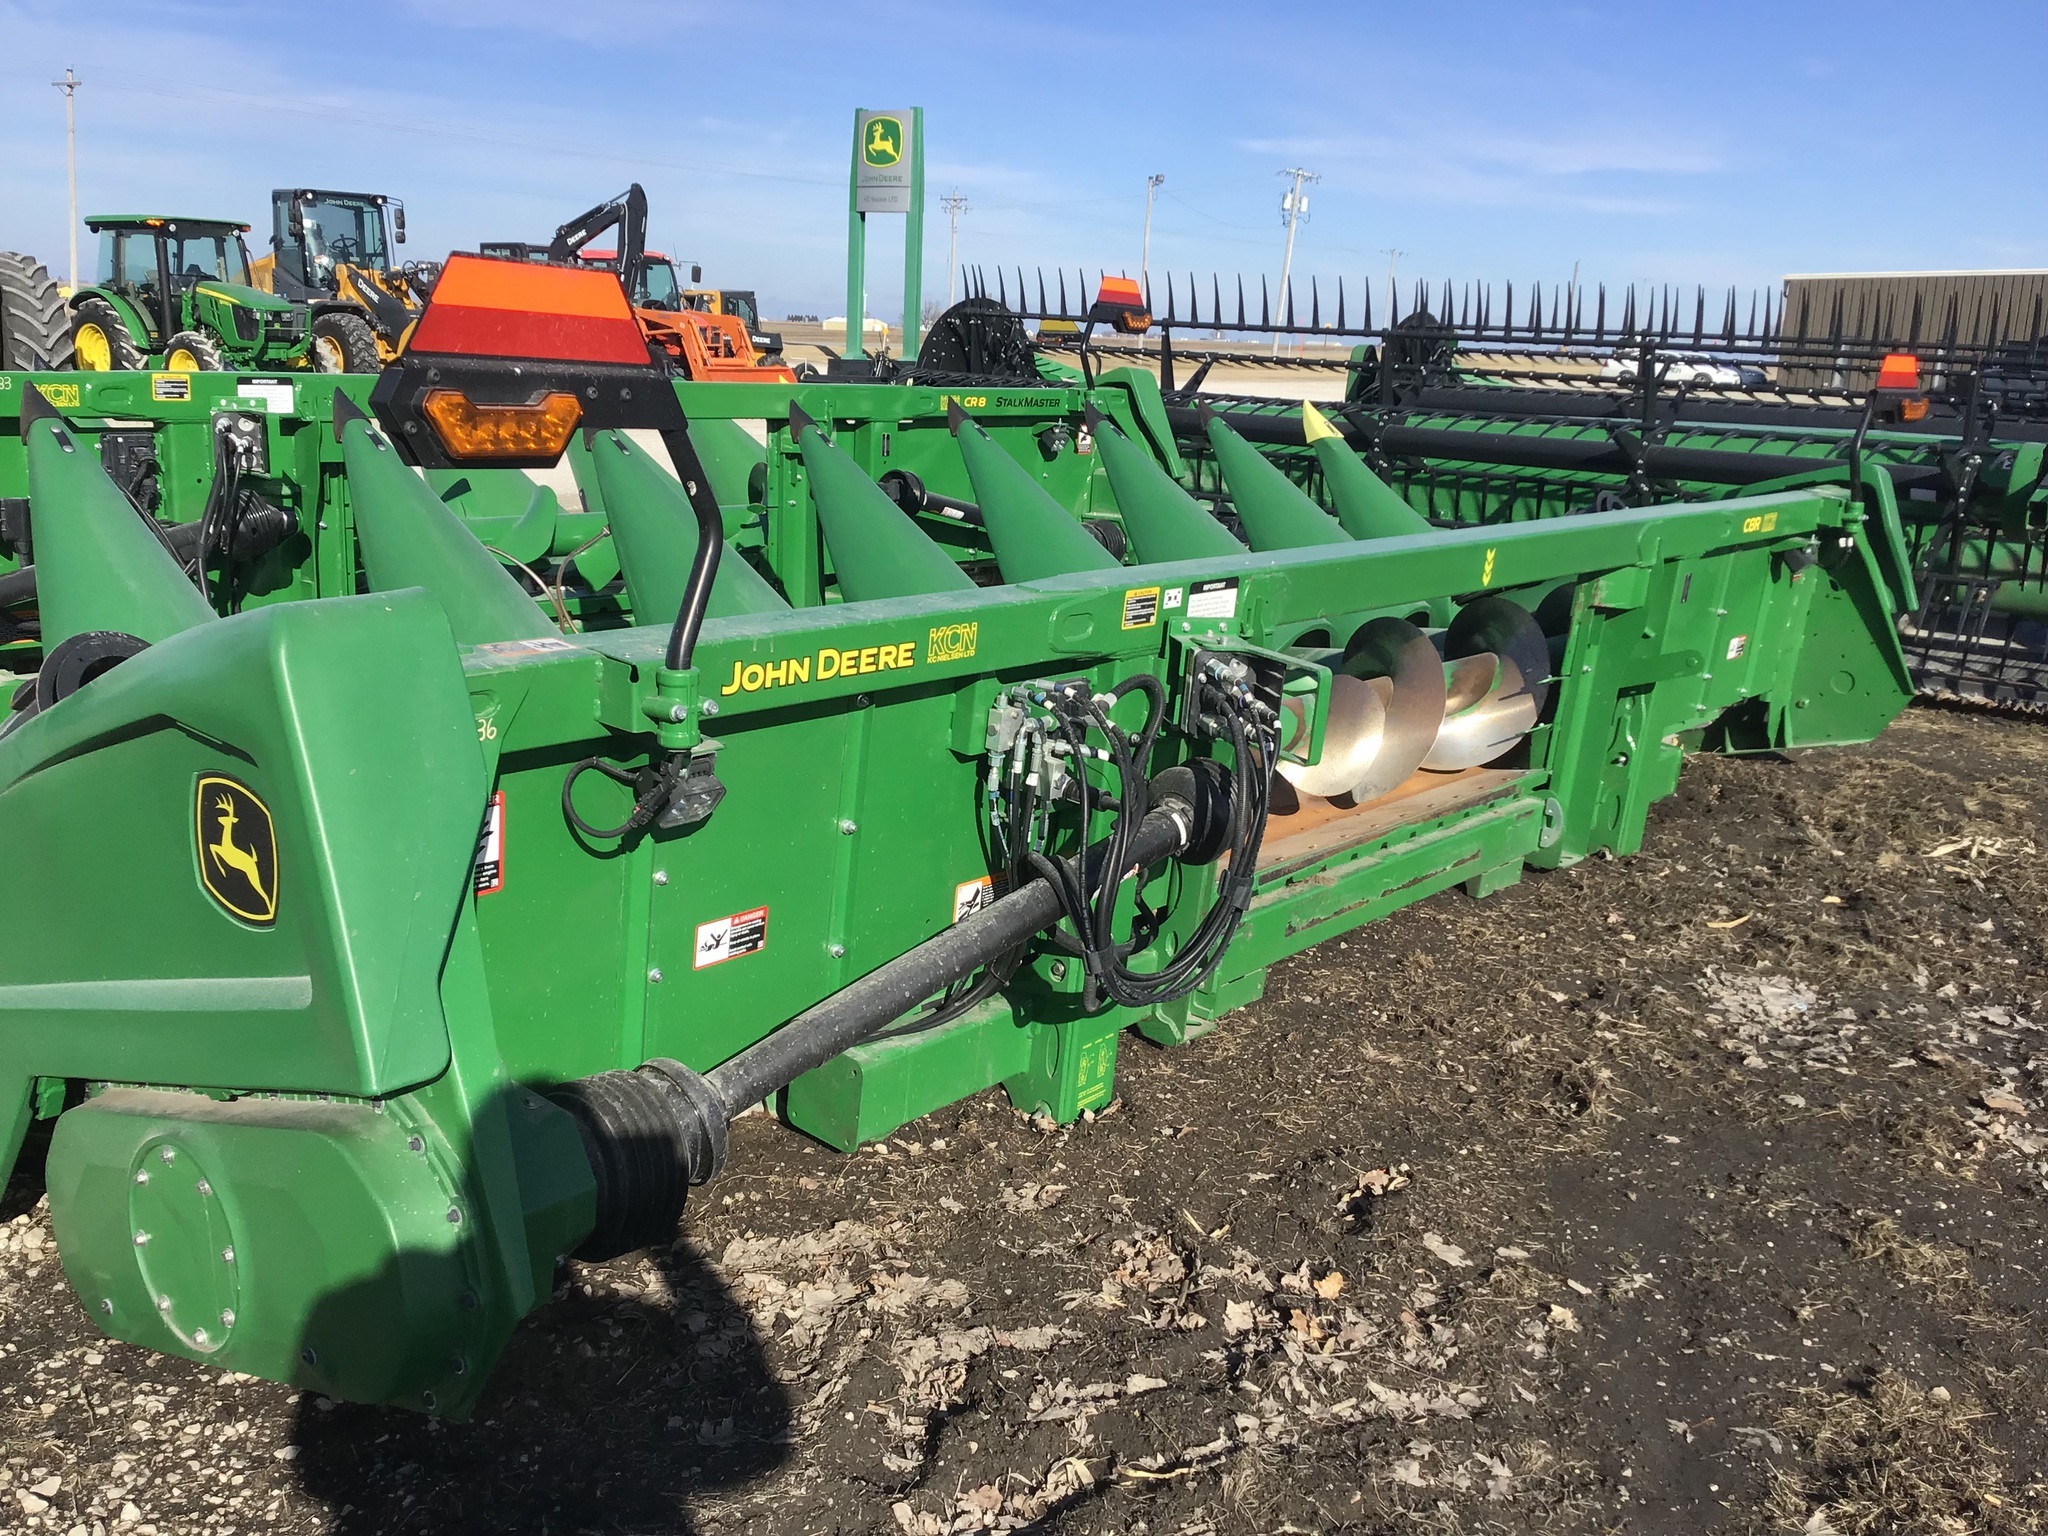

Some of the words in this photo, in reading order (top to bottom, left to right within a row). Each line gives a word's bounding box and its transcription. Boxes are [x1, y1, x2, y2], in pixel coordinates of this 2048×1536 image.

[879, 174, 903, 182] DEERE
[344, 199, 364, 207] DEERE
[888, 195, 898, 203] LTD
[566, 229, 587, 246] DEERE
[357, 277, 380, 304] DEERE
[752, 335, 771, 344] DEERE
[1202, 581, 1227, 591] IMPORTANT
[928, 622, 979, 658] KCN
[937, 651, 963, 663] NIELSEN
[963, 649, 976, 658] LTD
[721, 657, 811, 696] JOHN
[816, 641, 917, 682] DEERE
[740, 909, 764, 922] DANGER
